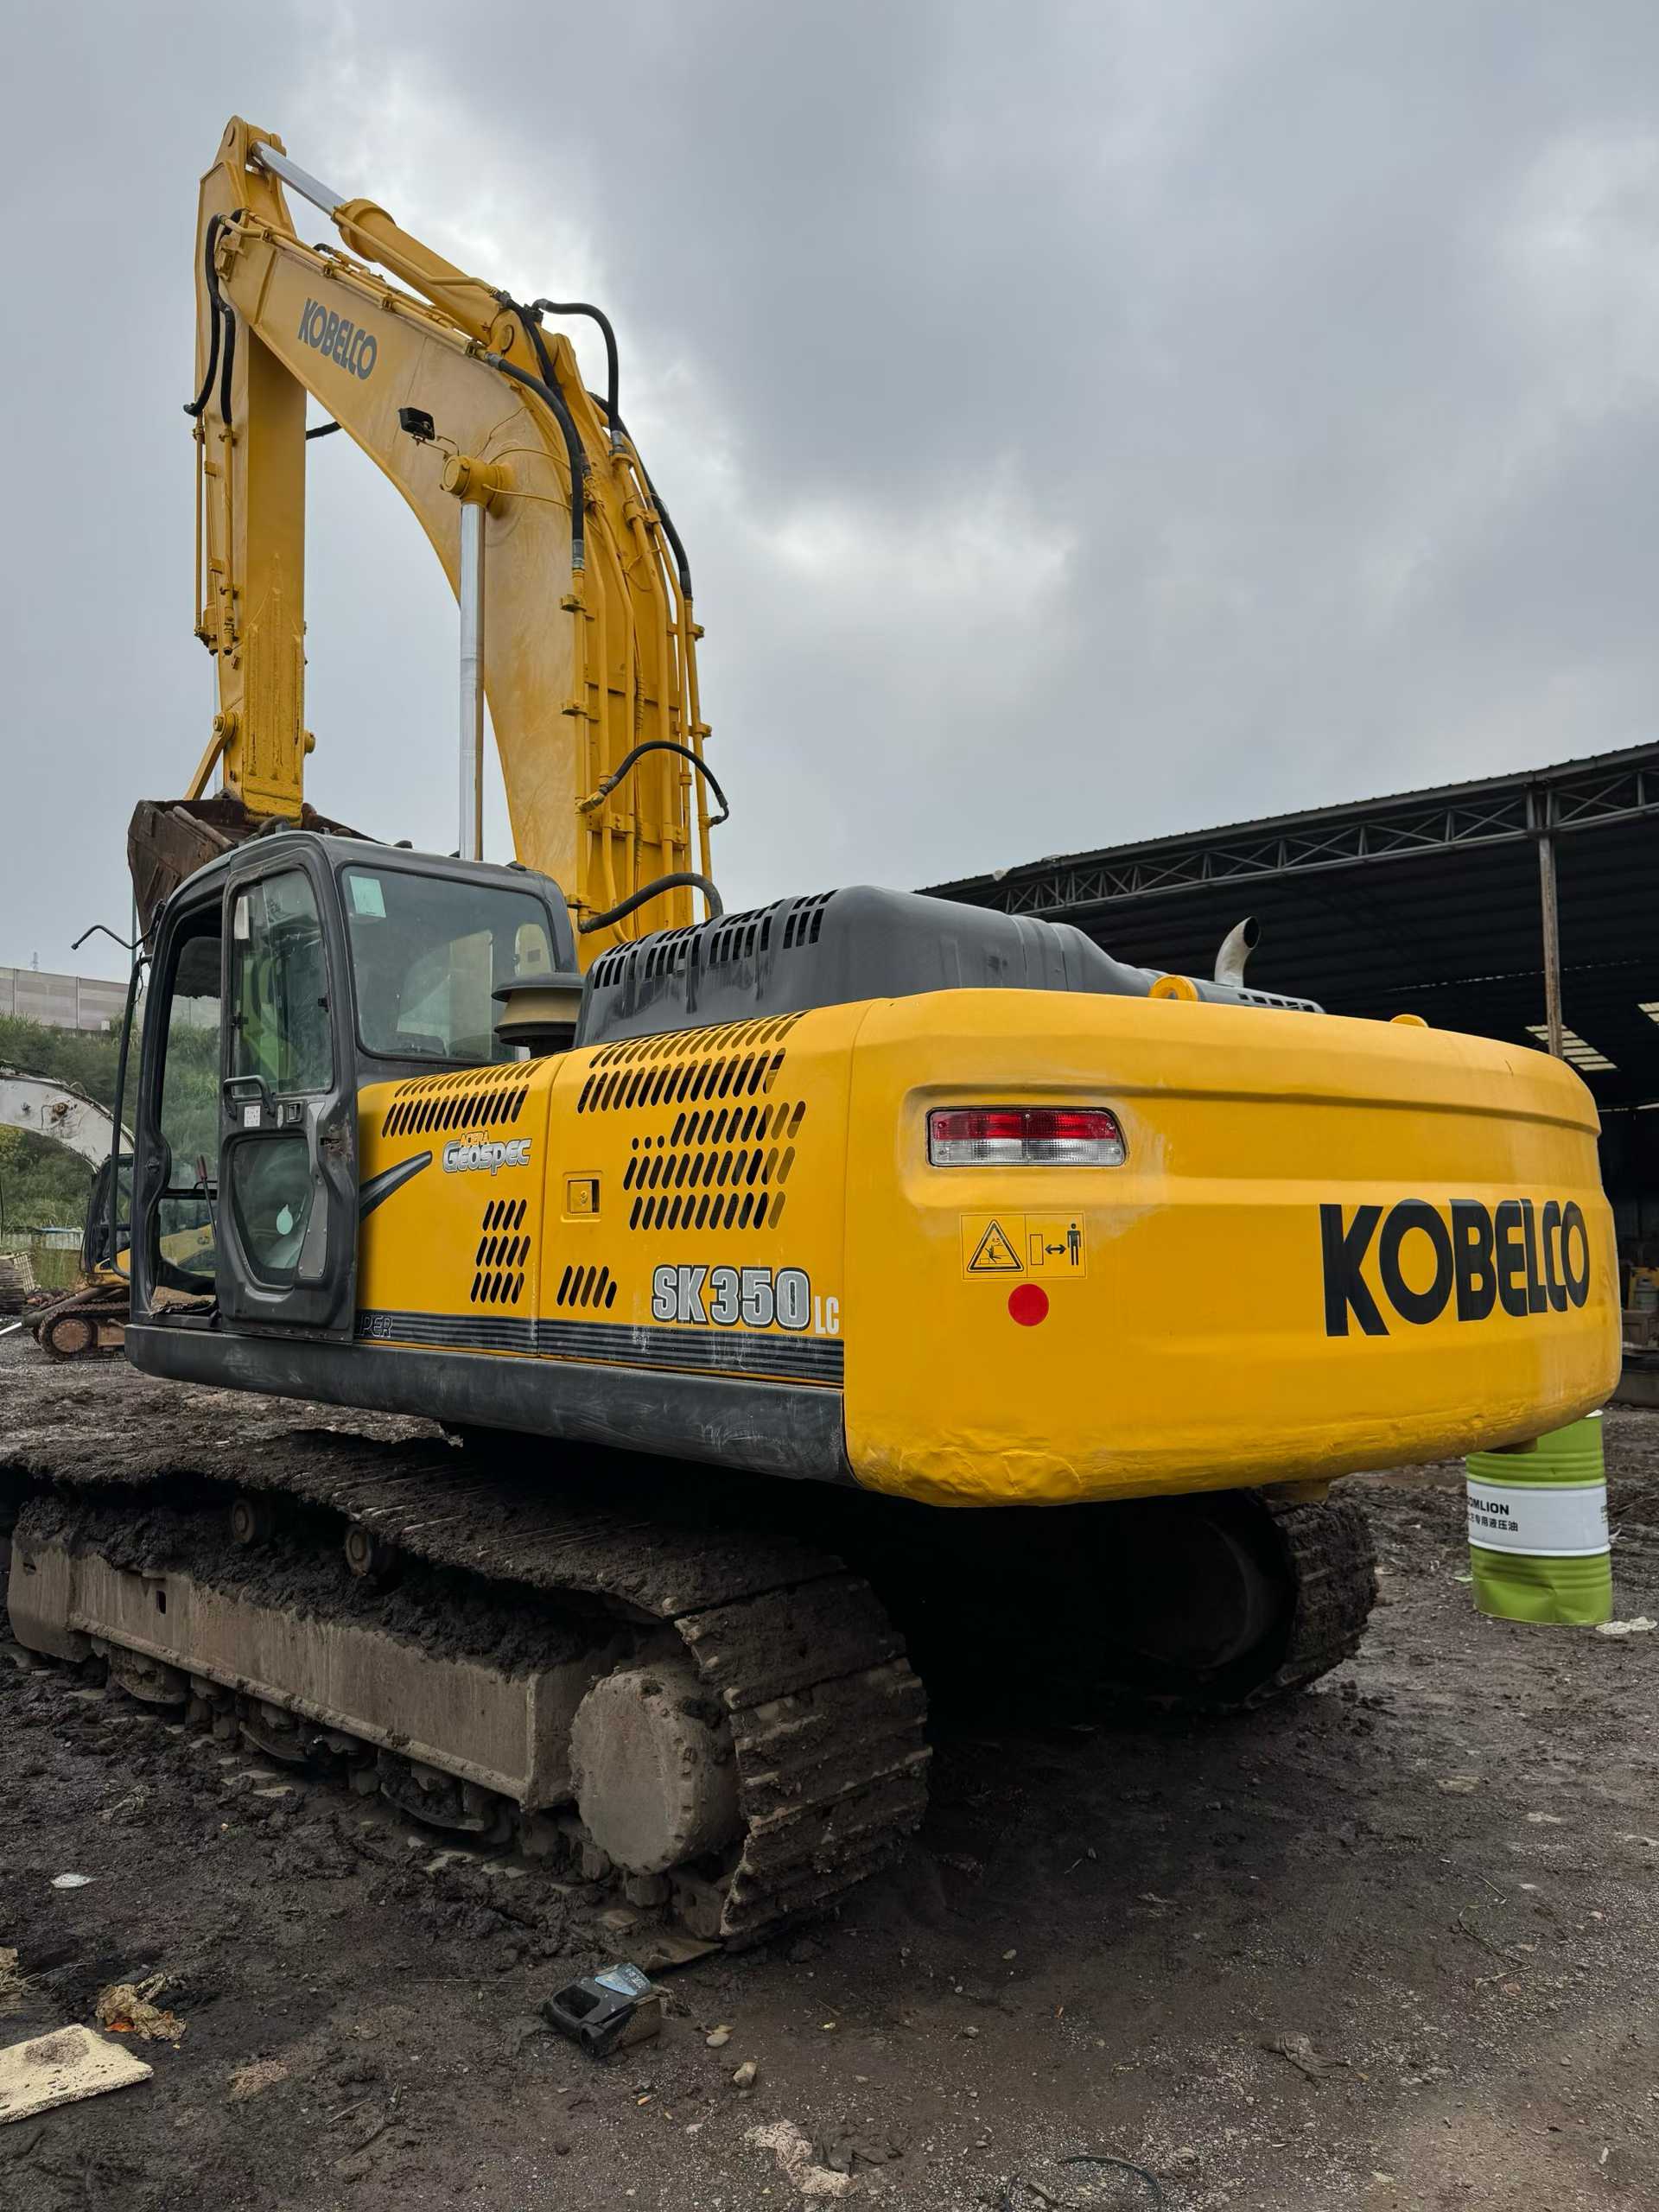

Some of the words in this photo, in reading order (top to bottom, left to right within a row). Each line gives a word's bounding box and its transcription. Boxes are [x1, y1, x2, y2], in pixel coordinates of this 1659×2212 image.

[298, 297, 378, 380] KOBELCO
[652, 1265, 810, 1331] SK350
[815, 1296, 840, 1334] LC
[1319, 1198, 1590, 1337] KOBELCO
